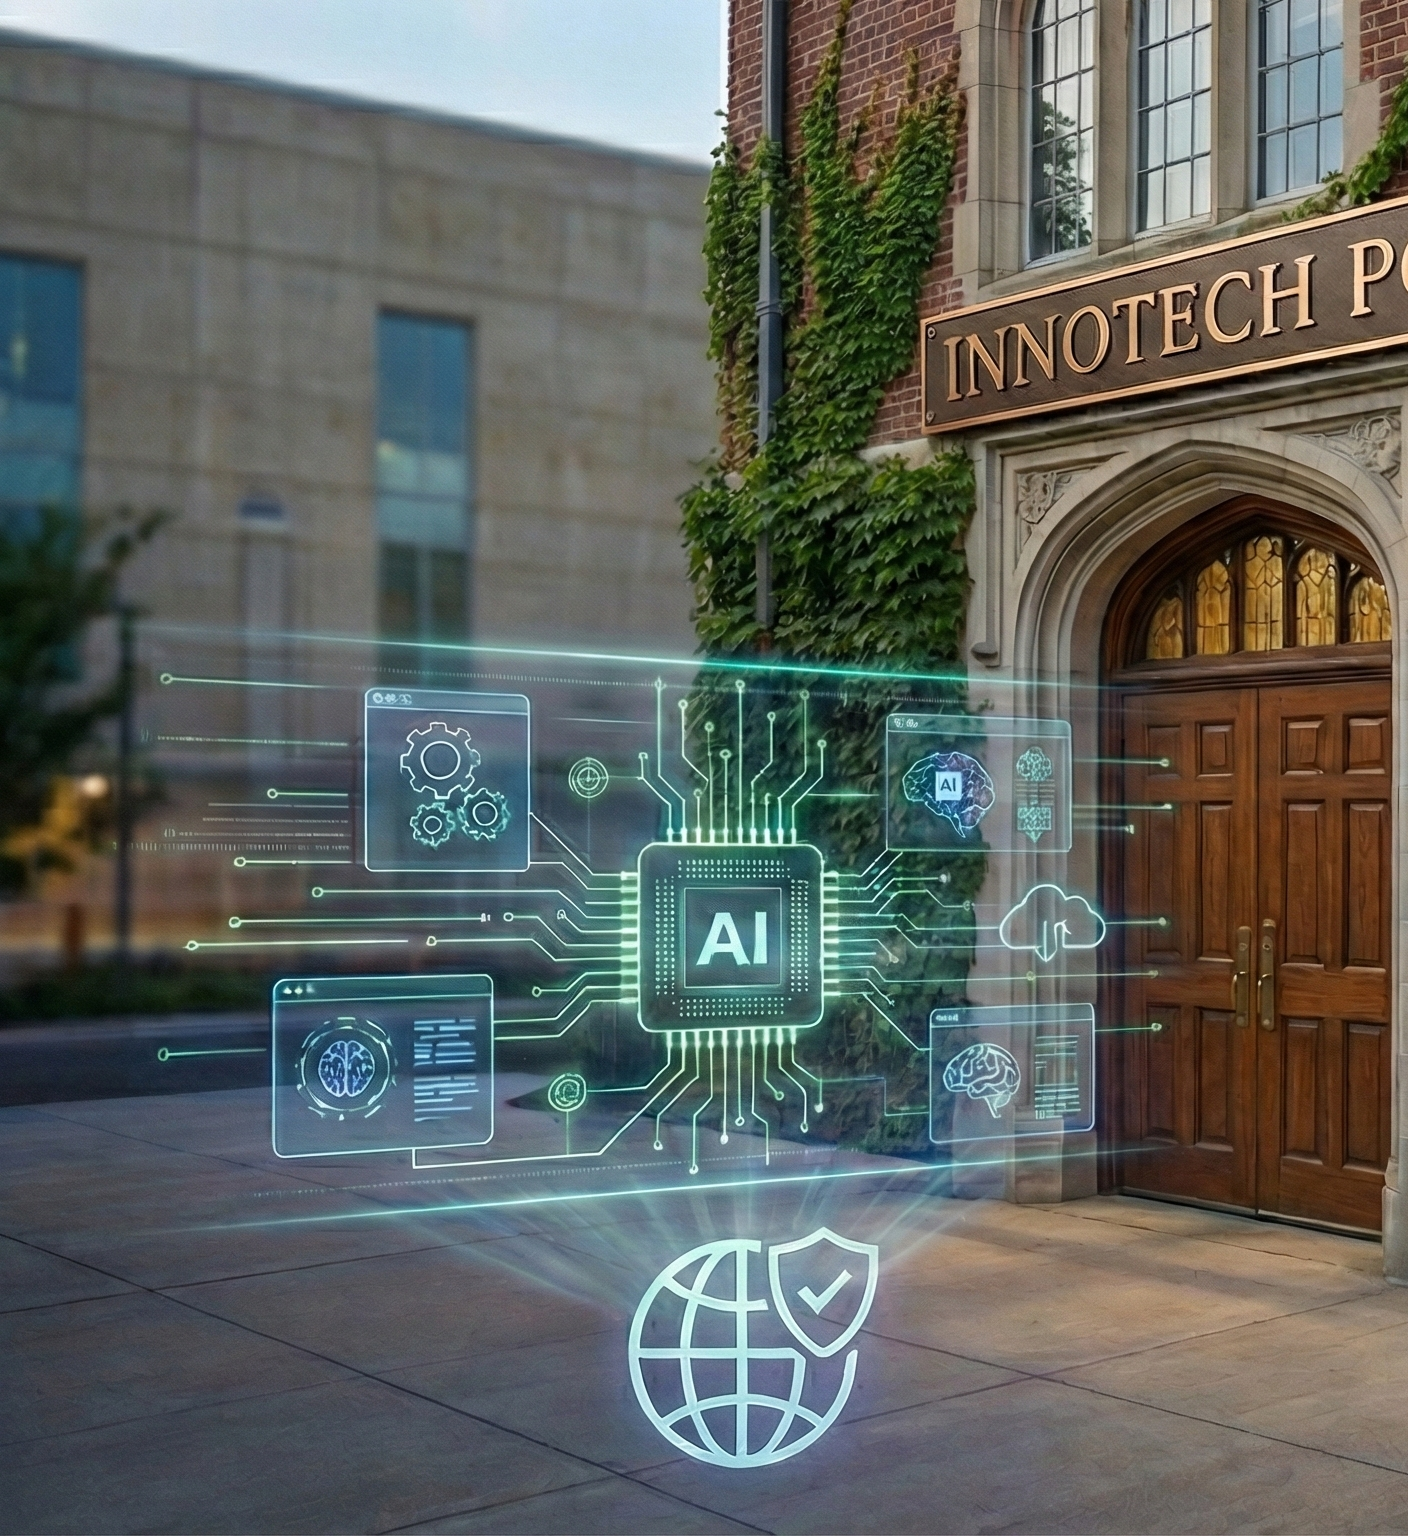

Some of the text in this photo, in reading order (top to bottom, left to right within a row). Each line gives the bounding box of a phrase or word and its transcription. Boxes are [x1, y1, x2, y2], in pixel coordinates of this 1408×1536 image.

[943, 254, 1317, 402] INNOTECH
[940, 777, 957, 792] AI
[696, 911, 768, 966] AI
